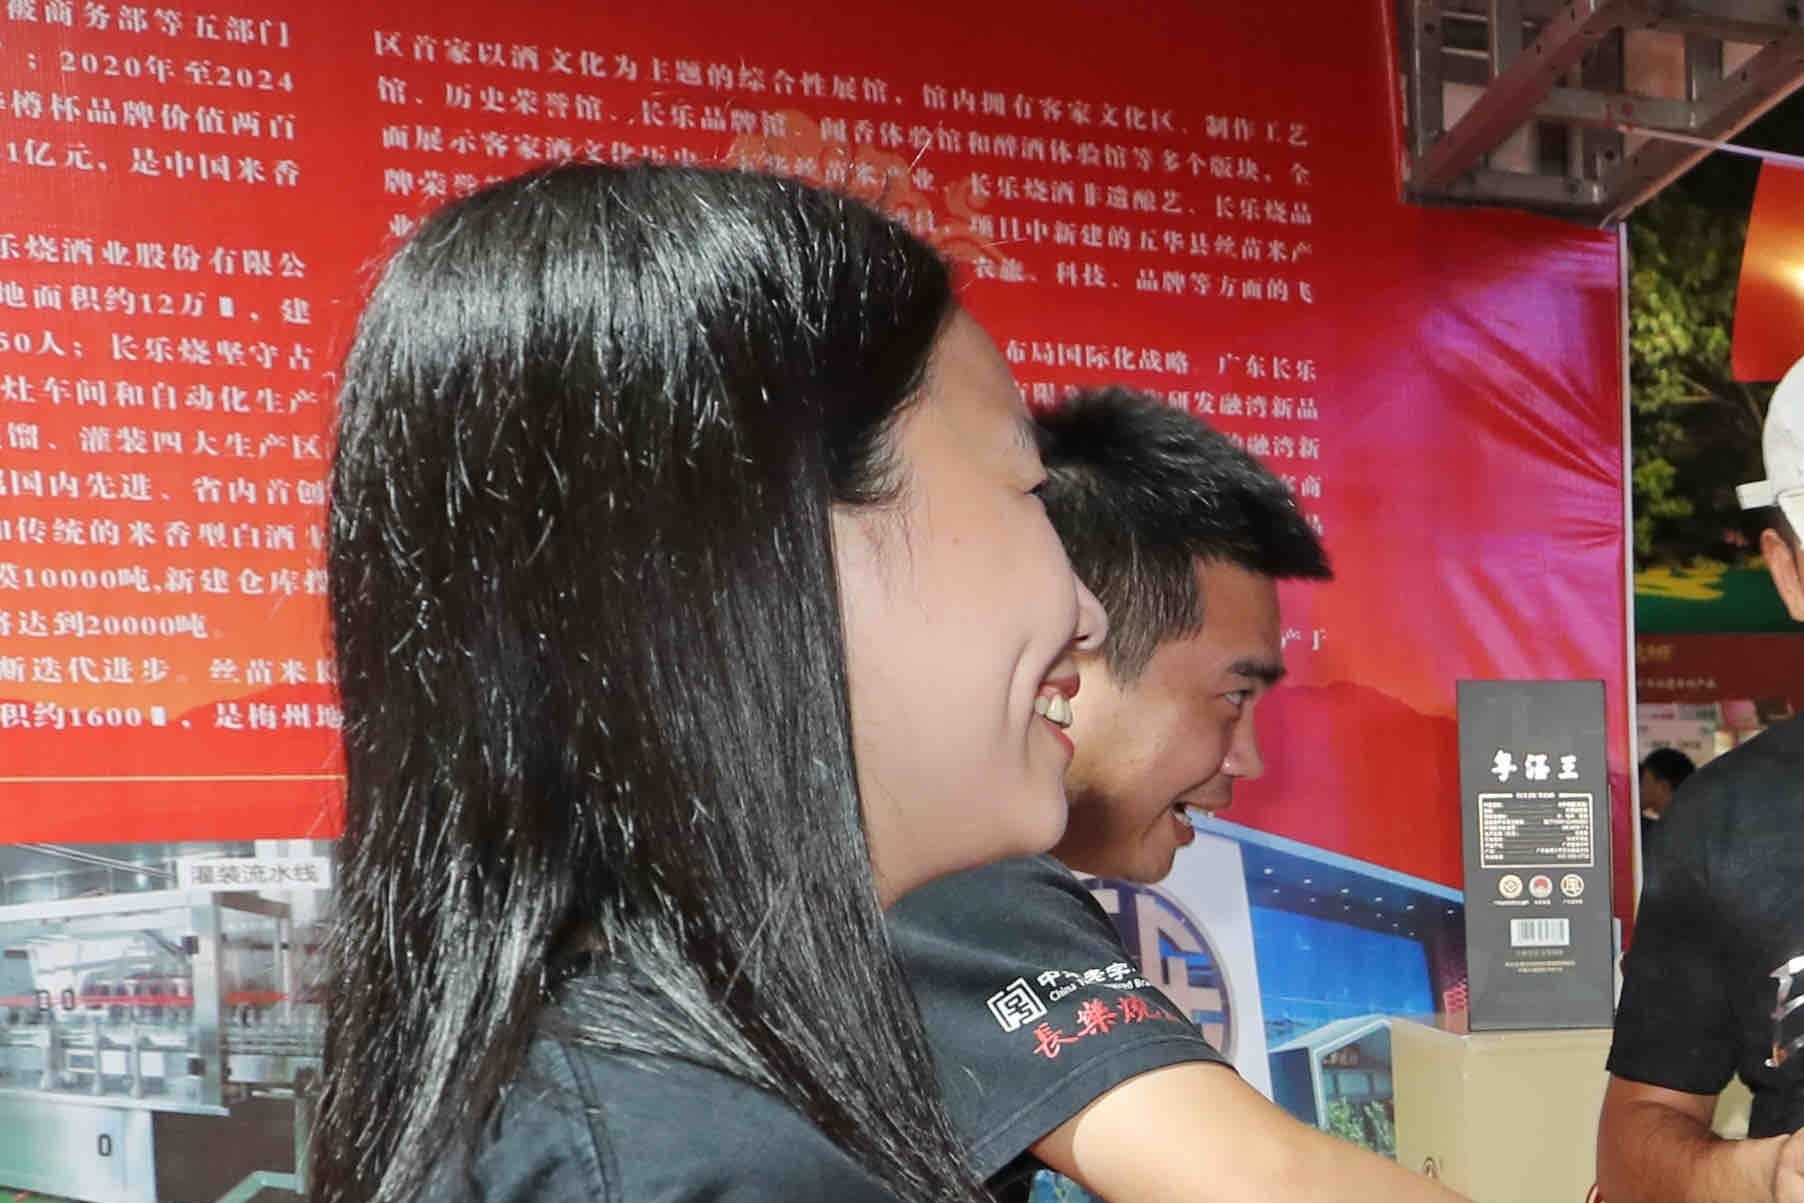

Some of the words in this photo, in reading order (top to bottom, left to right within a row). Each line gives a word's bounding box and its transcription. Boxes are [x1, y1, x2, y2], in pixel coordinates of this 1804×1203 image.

[0, 88, 297, 140] 樽杯品牌价值两百
[0, 421, 323, 461] 馏、灌装四大生产区
